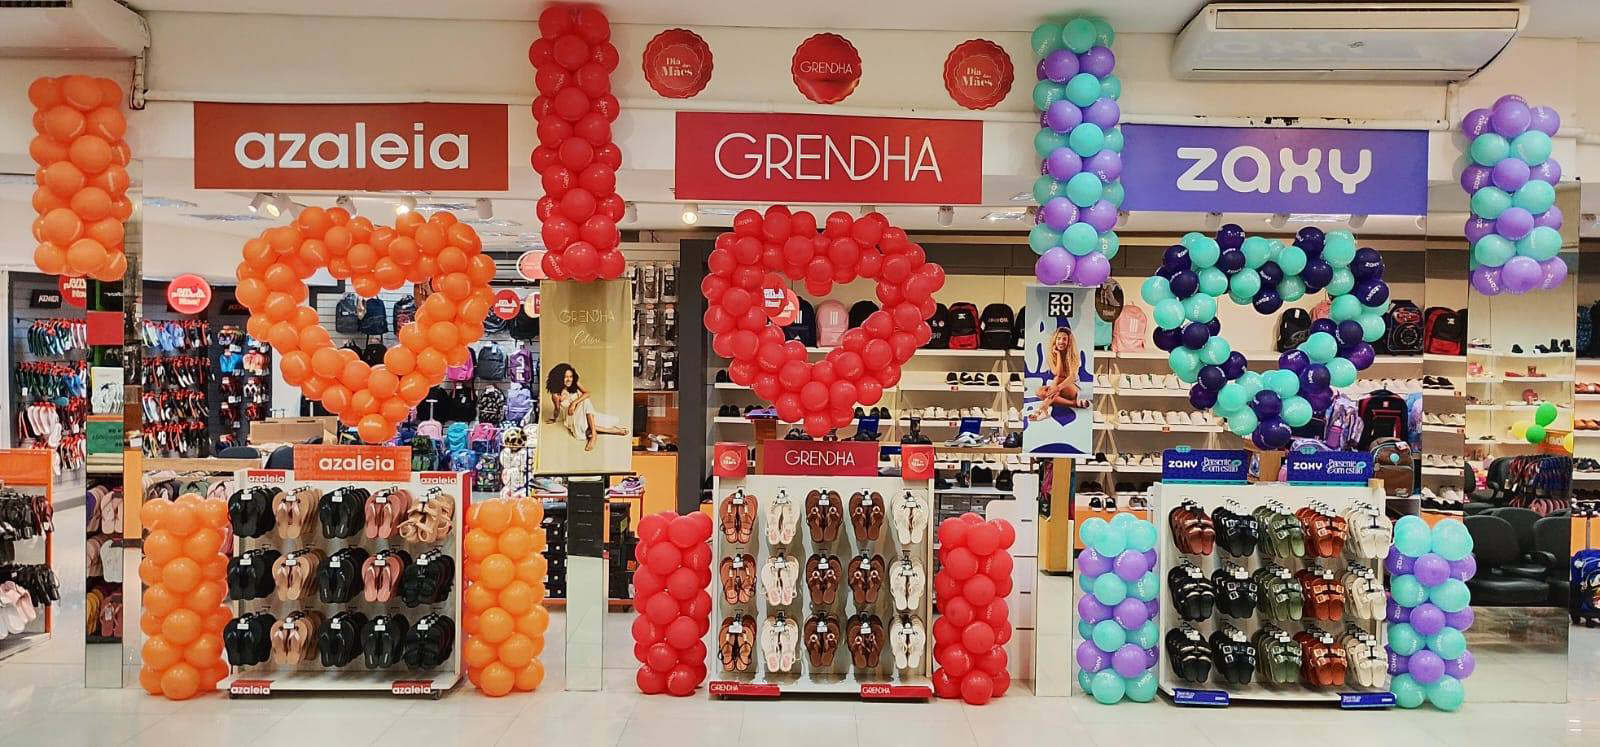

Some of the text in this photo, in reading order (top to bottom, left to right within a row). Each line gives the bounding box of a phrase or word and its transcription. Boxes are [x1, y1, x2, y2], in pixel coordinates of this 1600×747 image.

[666, 57, 681, 65] Dia
[661, 66, 693, 76] Mães
[800, 60, 853, 75] GRENDHA
[967, 66, 982, 75] Dia
[962, 75, 993, 87] Mães
[234, 122, 469, 170] azaleia
[714, 132, 942, 182] GRENDHA
[1176, 145, 1372, 194] zaxy
[559, 309, 615, 323] GRENDHA
[785, 449, 856, 466] GRENDHA
[318, 455, 395, 471] azaleia
[1168, 460, 1198, 468] zaxy
[1293, 462, 1323, 470] zaxy
[248, 473, 285, 483] azaleia
[420, 473, 457, 484] azaleia
[231, 686, 270, 694] azaleia
[392, 685, 431, 694] azaleia
[710, 683, 739, 692] GRENDHA
[862, 686, 891, 694] GRENDHA
